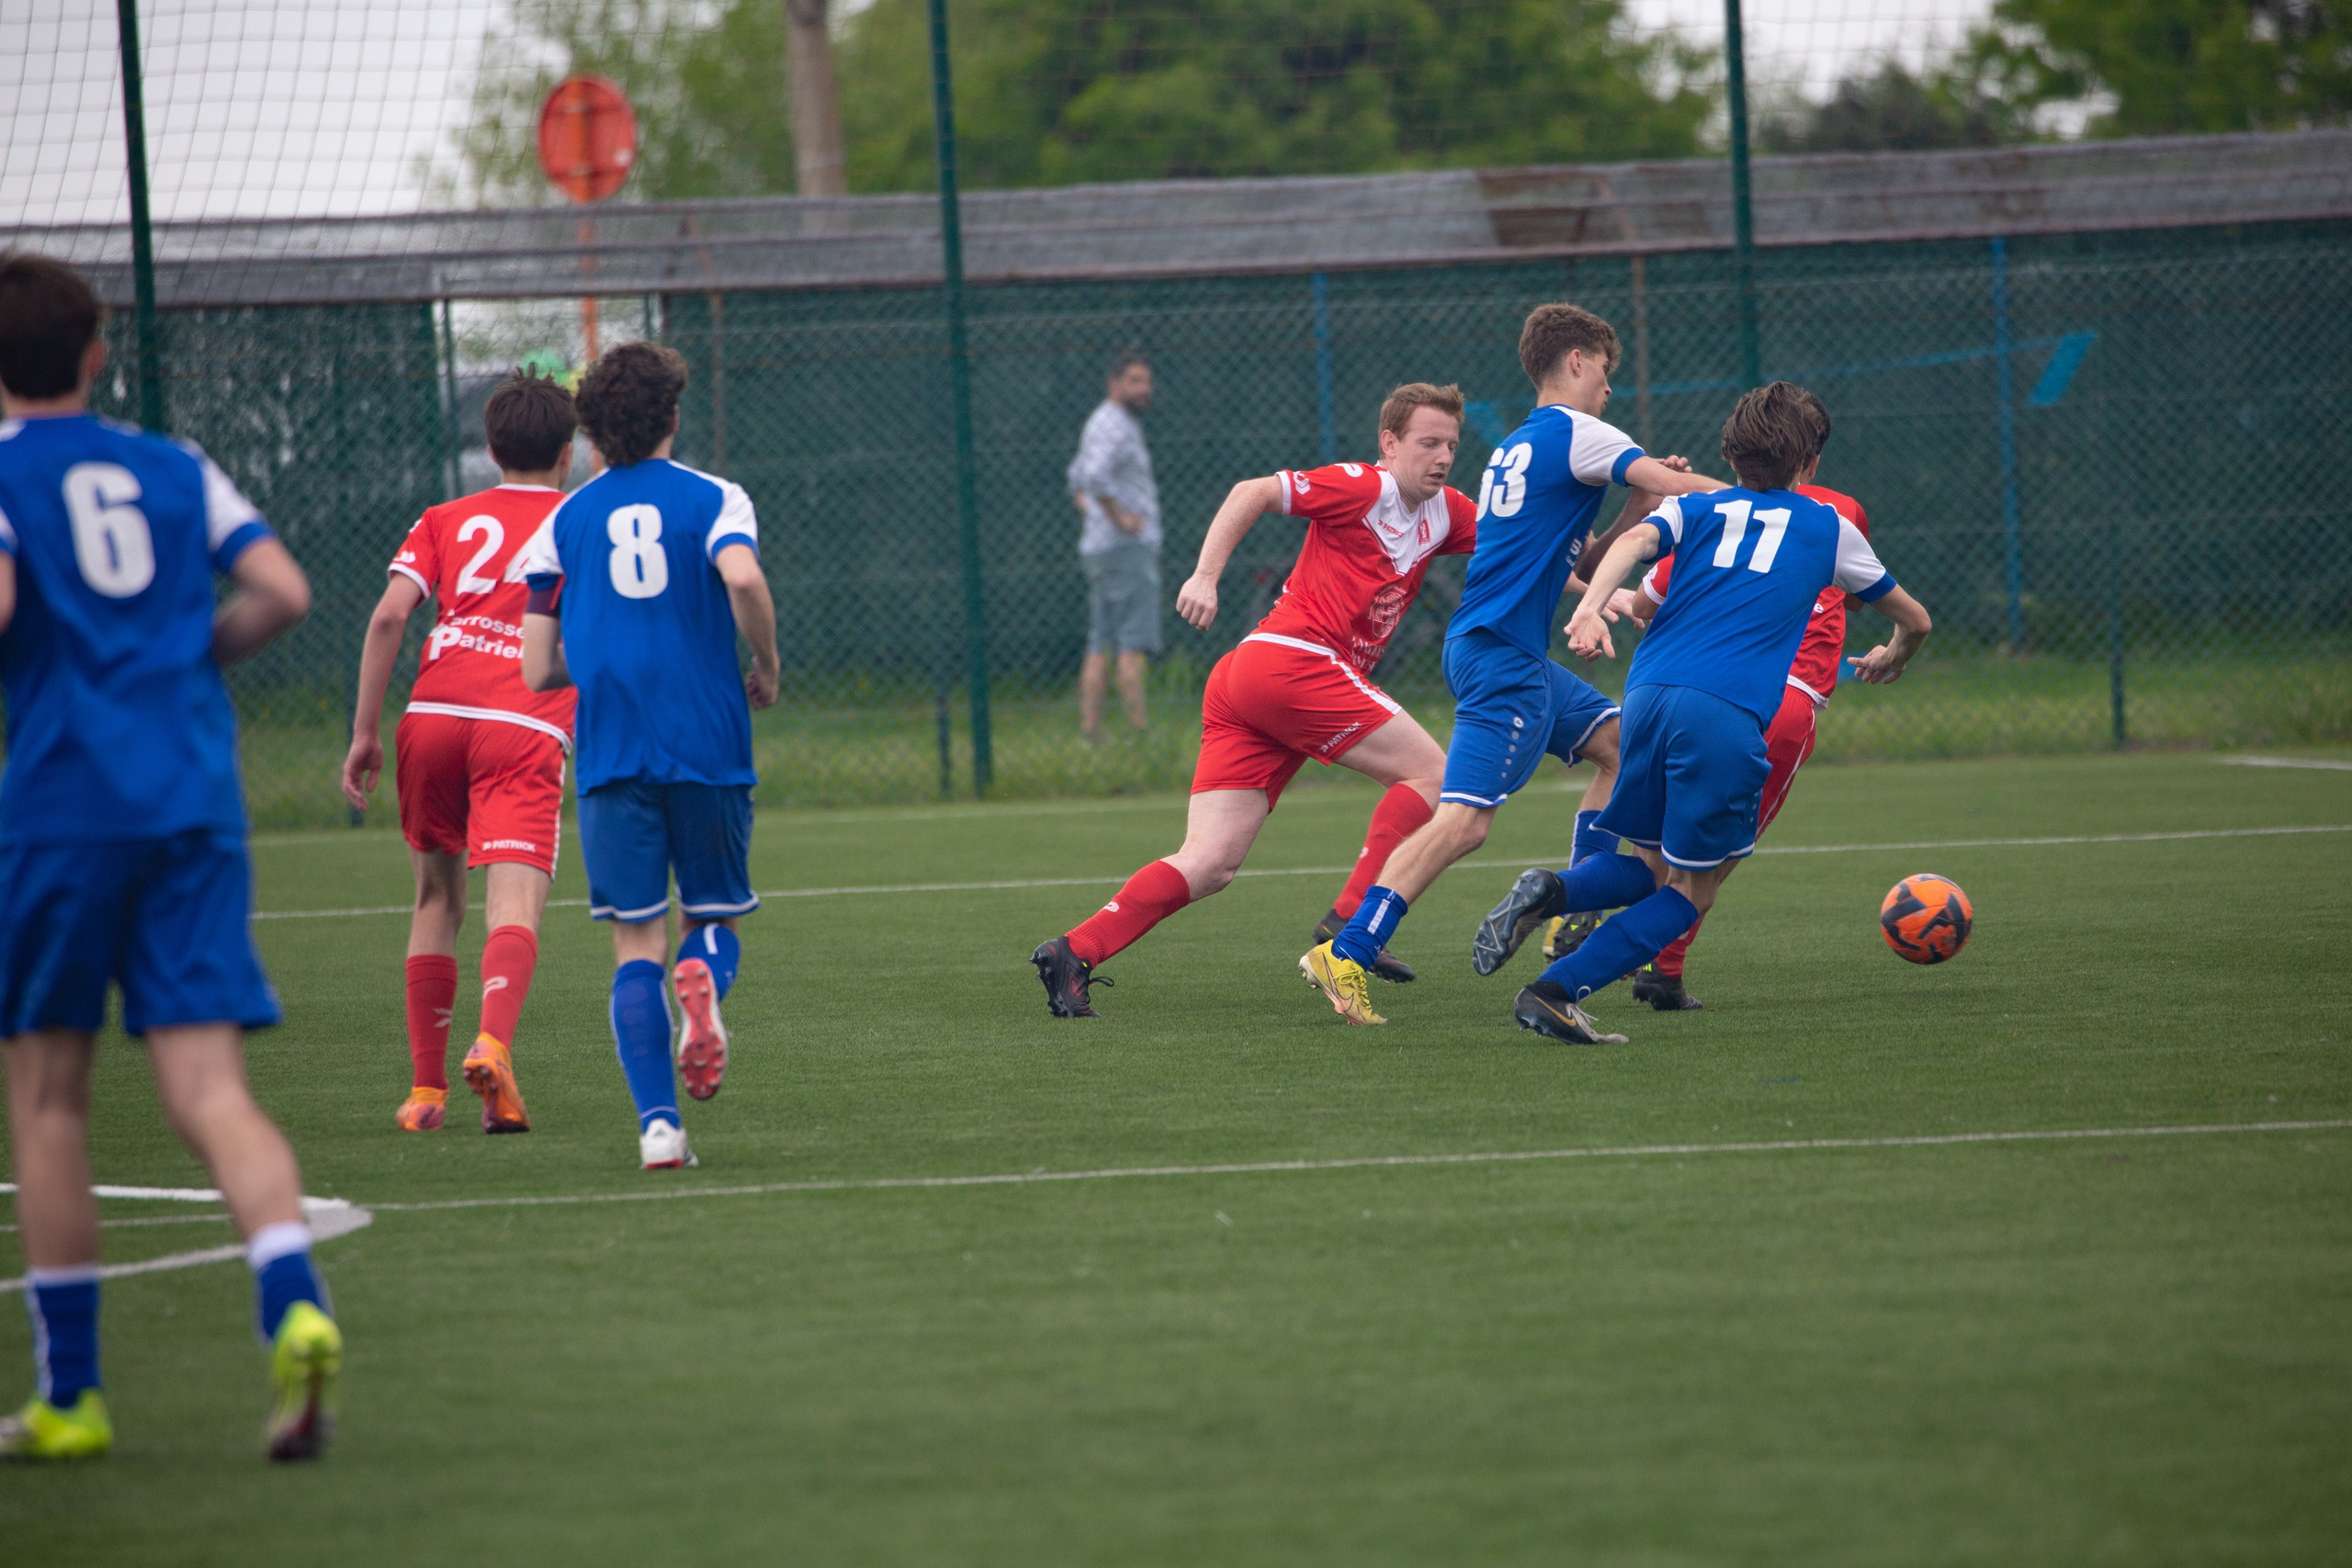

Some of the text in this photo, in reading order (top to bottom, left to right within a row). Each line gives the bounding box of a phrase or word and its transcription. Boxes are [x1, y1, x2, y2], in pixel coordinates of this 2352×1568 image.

[62, 460, 156, 598] 6
[607, 503, 669, 599] 8
[1713, 500, 1792, 573] 11
